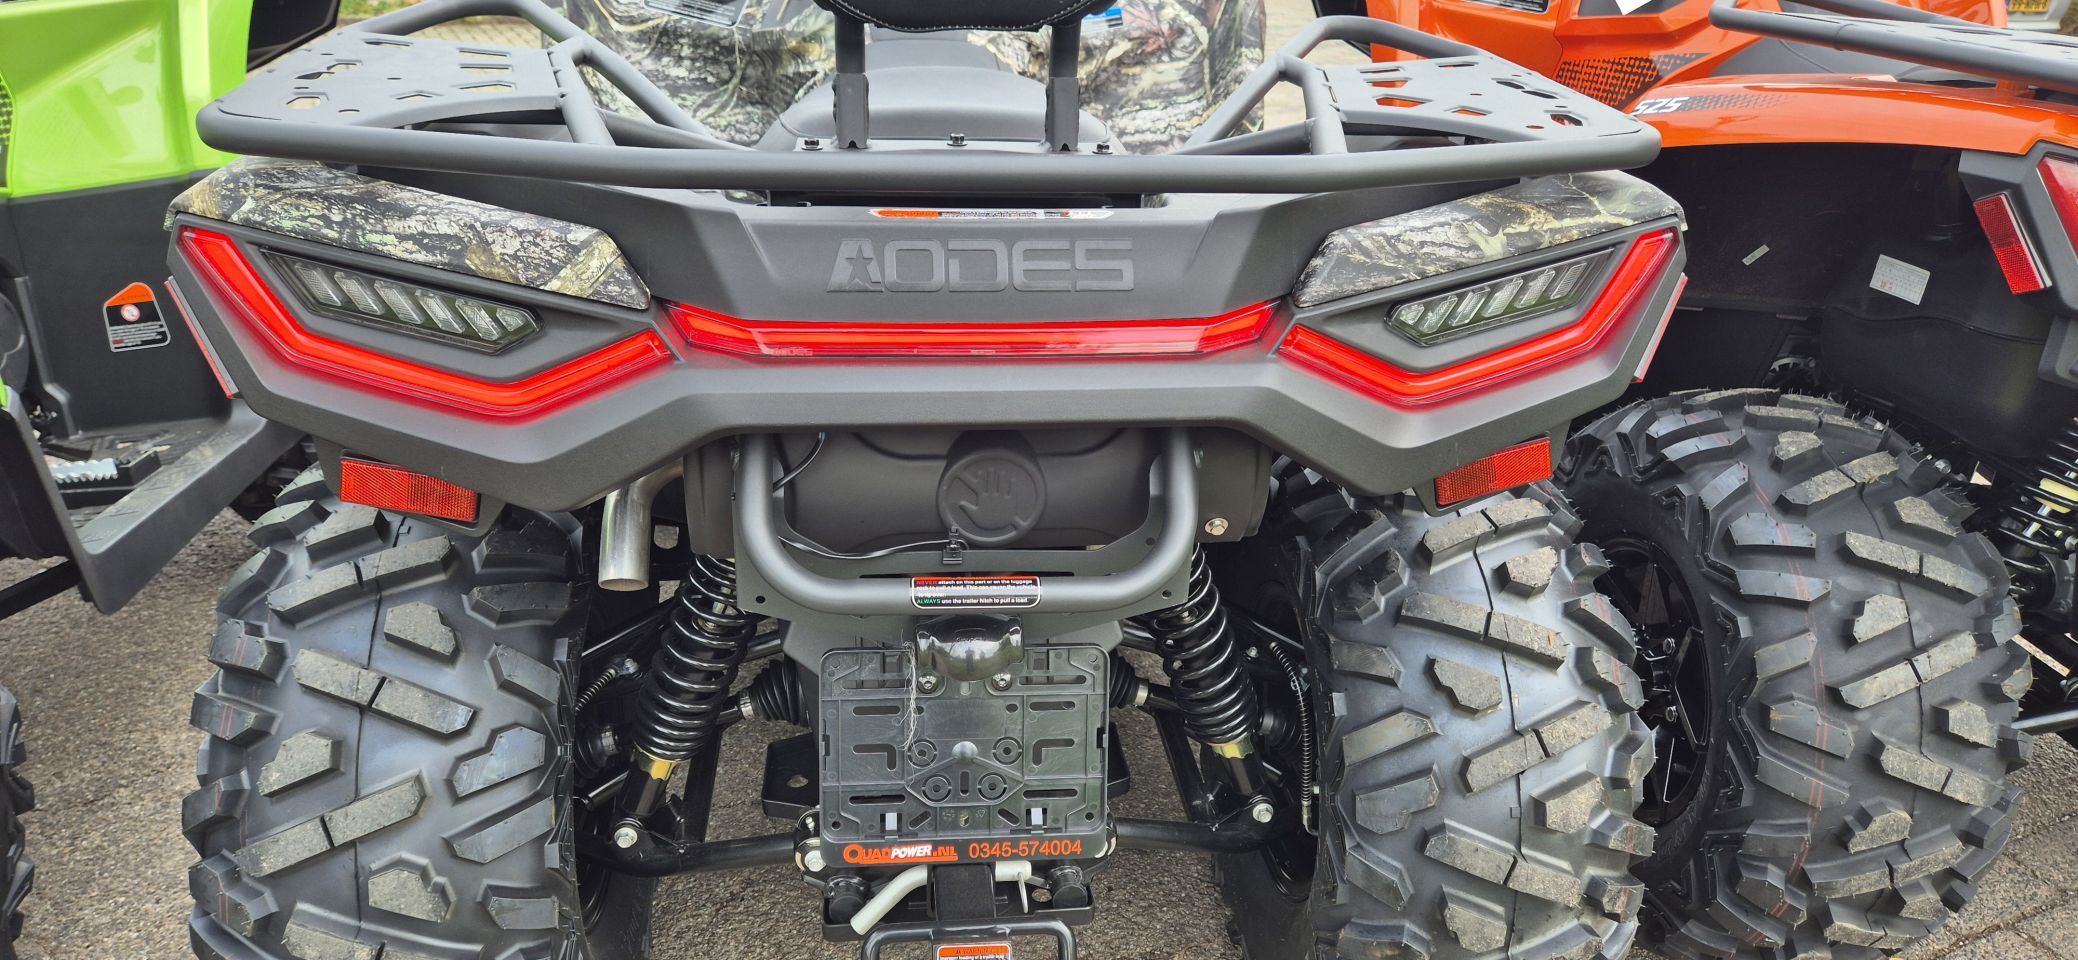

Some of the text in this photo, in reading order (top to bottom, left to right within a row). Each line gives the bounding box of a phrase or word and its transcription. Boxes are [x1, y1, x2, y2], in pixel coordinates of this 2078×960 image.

[1631, 96, 1690, 116] 525
[826, 238, 1135, 293] AODES
[968, 840, 1082, 859] 0345-574004
